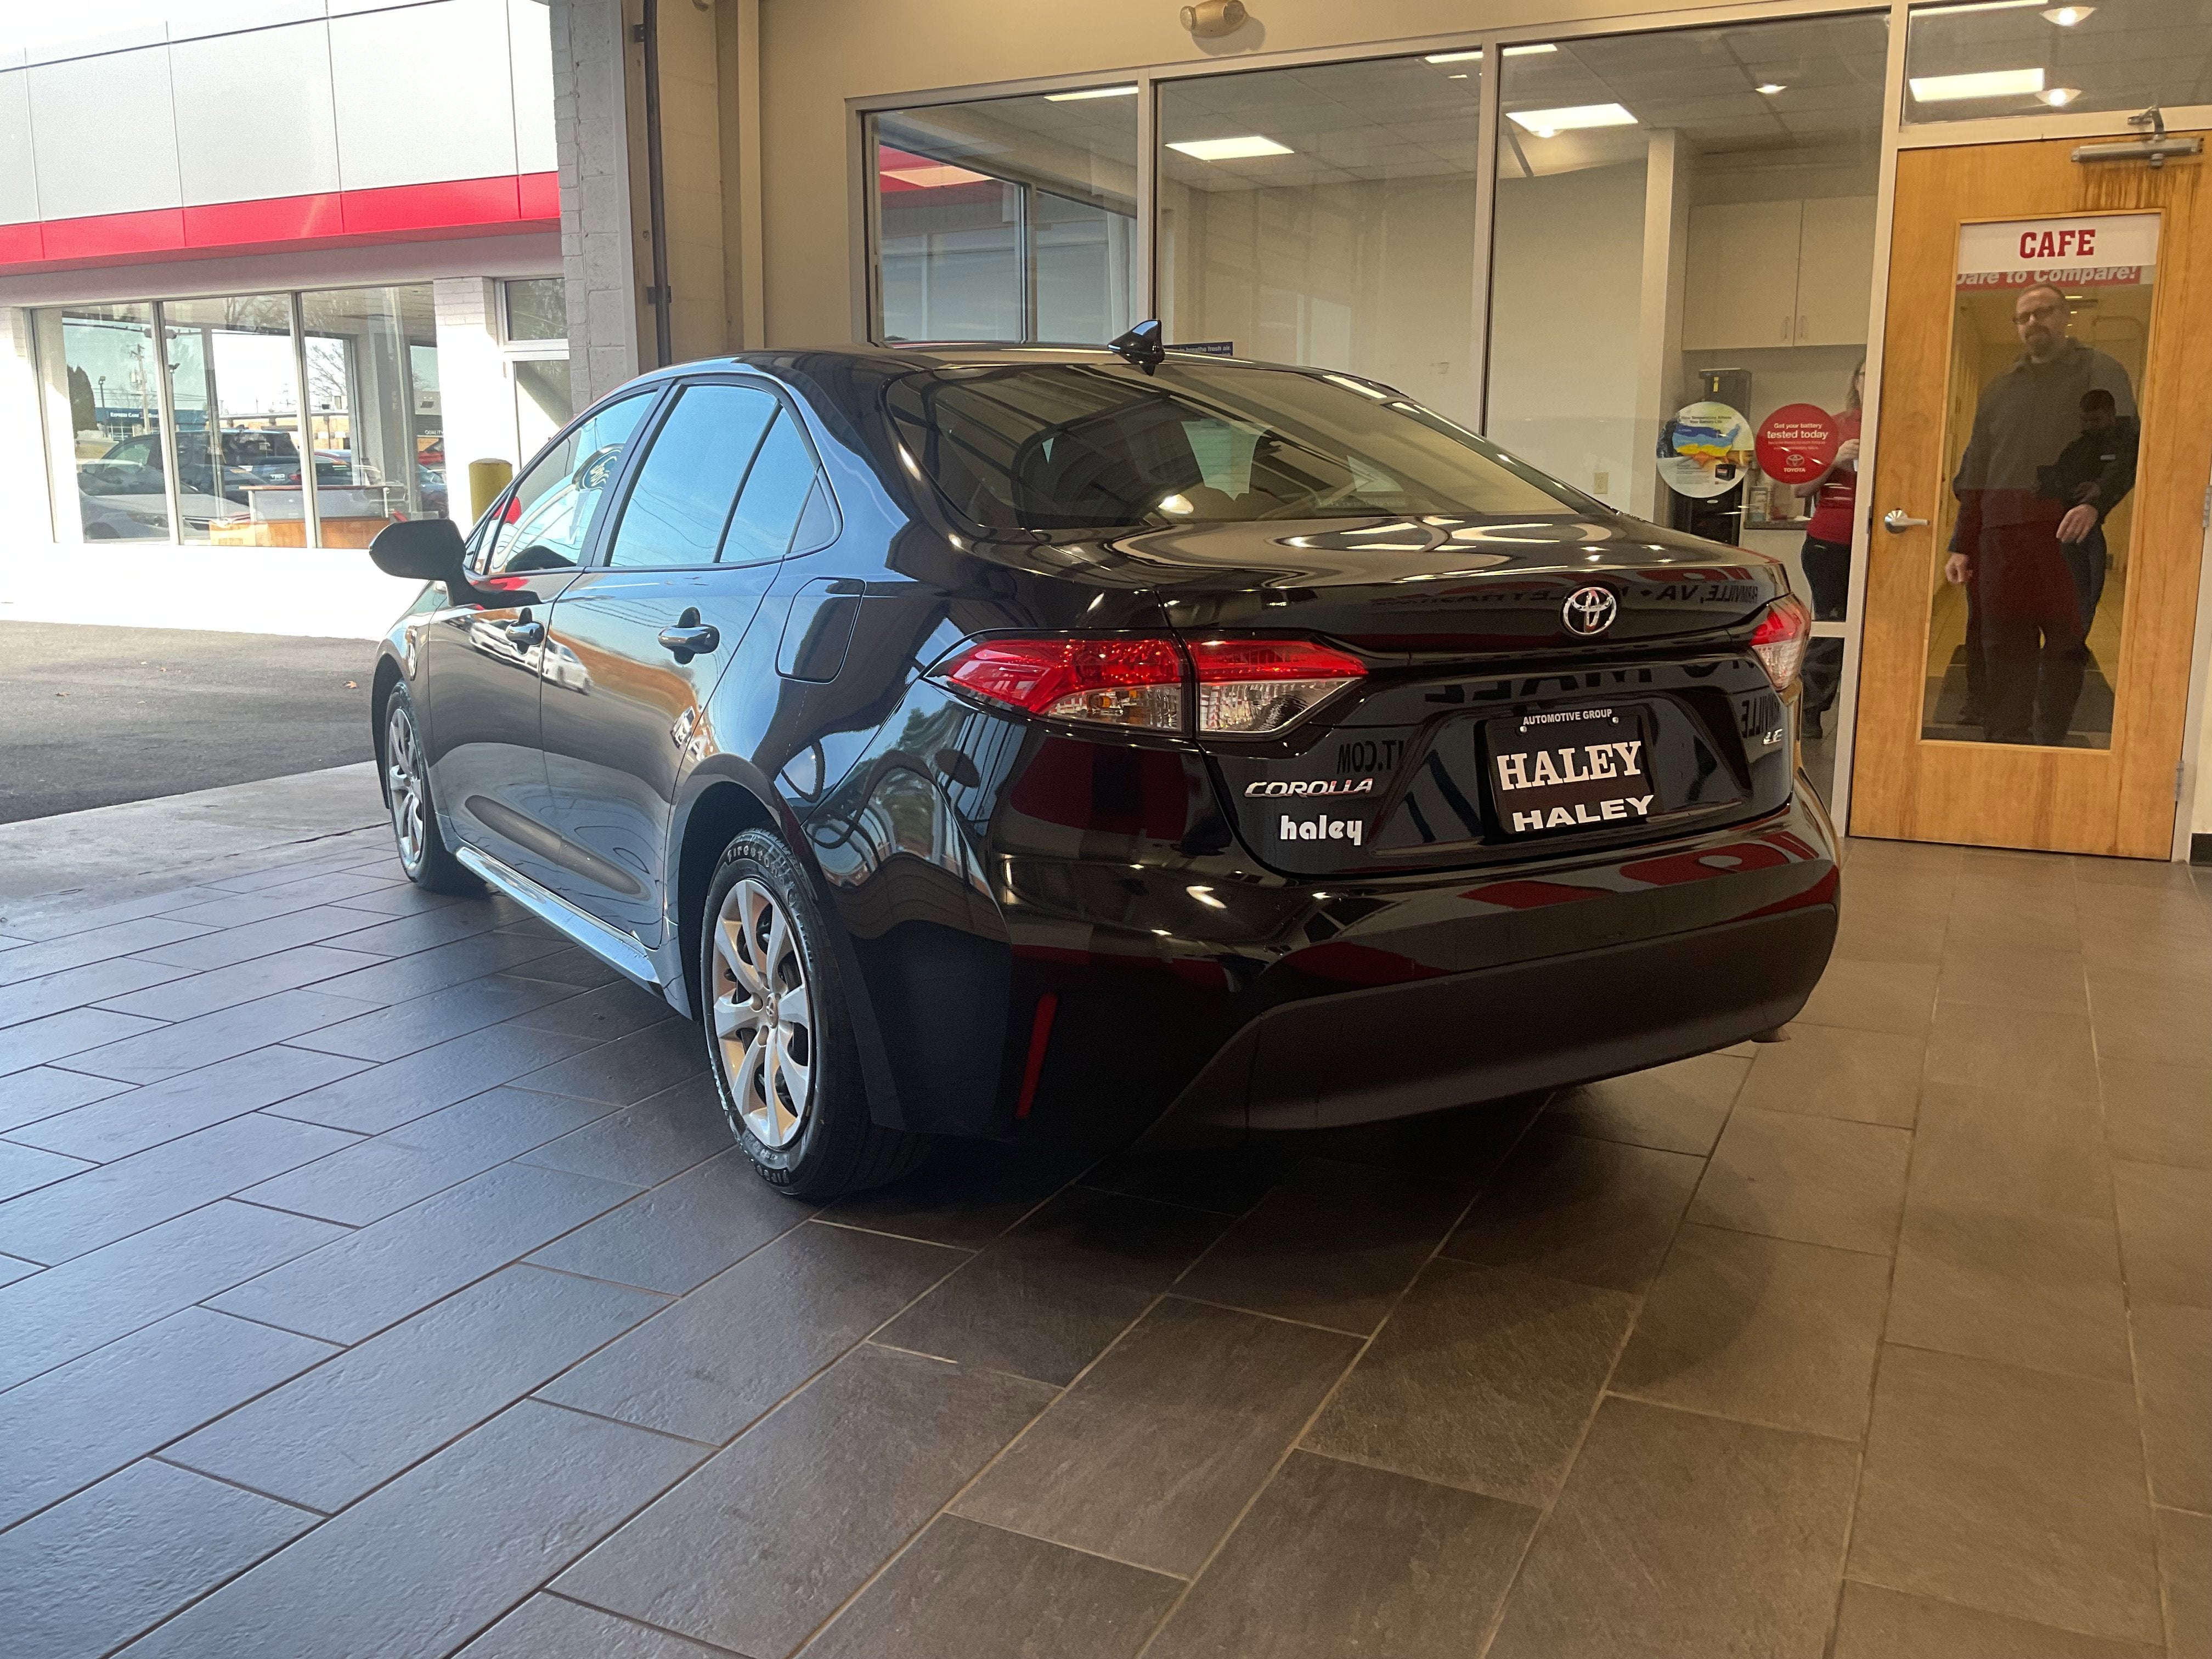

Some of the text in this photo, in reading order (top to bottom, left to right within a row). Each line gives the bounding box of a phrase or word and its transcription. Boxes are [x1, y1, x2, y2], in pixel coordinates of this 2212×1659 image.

[2019, 229, 2096, 258] CAFE
[2006, 270, 2027, 283] to
[1767, 430, 1829, 440] tested today
[1523, 709, 1612, 725] AUTOMOTIVE GROUP
[1497, 741, 1641, 791] HALEY
[1244, 778, 1373, 798] COROLLA
[1512, 795, 1654, 832] HALEY
[1280, 815, 1362, 845] haley
